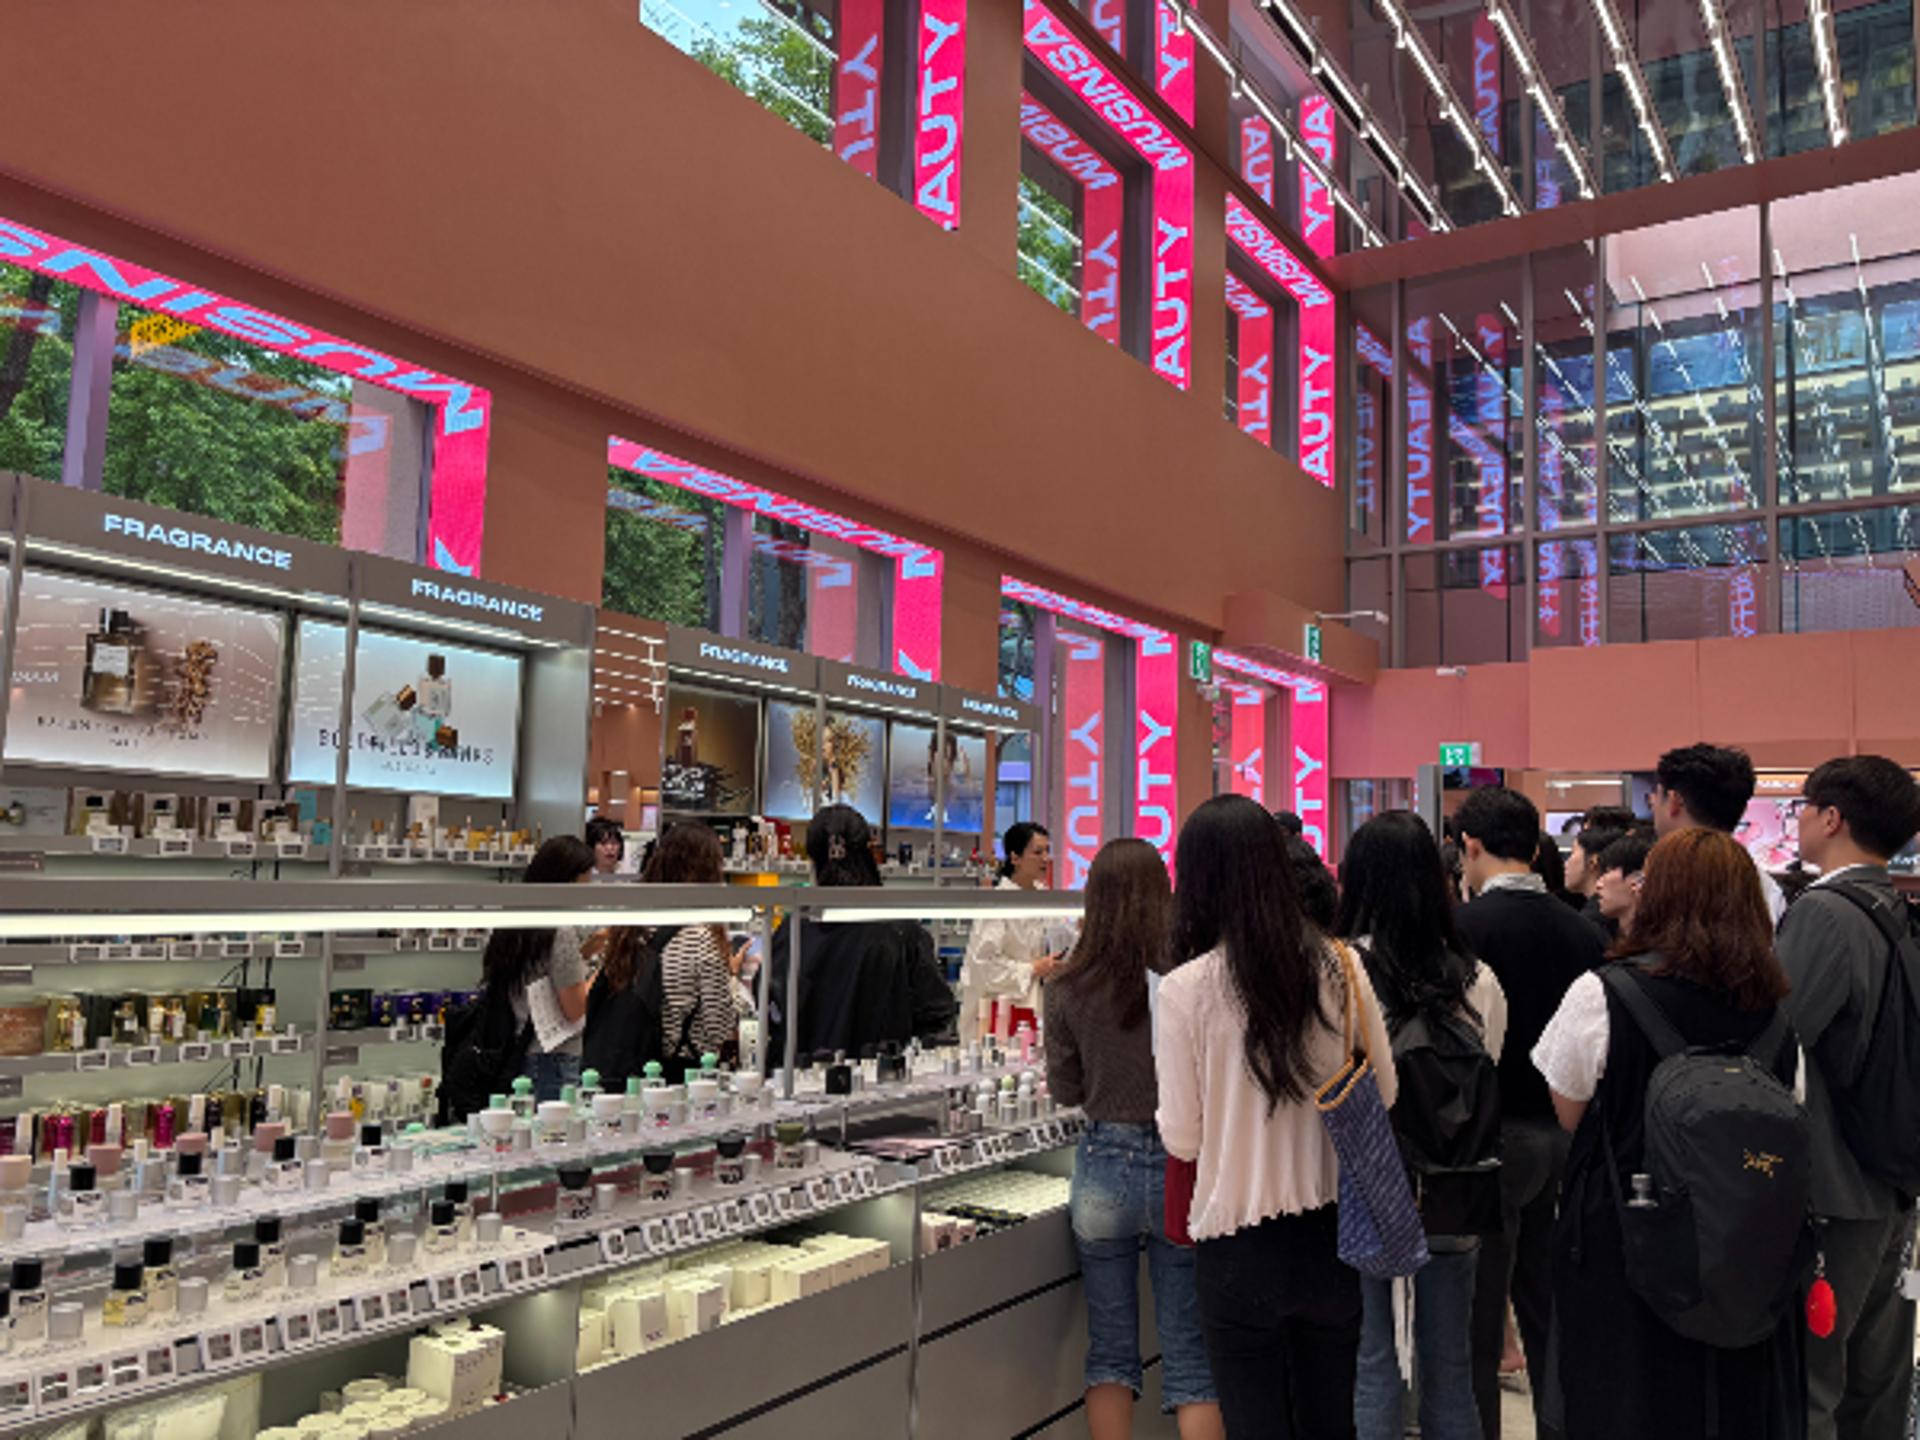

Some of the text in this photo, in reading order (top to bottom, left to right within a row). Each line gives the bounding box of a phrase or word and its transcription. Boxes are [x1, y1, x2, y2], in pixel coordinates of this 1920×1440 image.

[918, 12, 960, 231] AUTY
[1024, 15, 1189, 171] MUSINSA
[1154, 217, 1189, 391] AUTY
[1302, 345, 1331, 488] AUTY
[104, 513, 293, 571] FRAGRANCE
[632, 451, 936, 580] MUSINSA
[411, 578, 545, 622] FRAGRANCE
